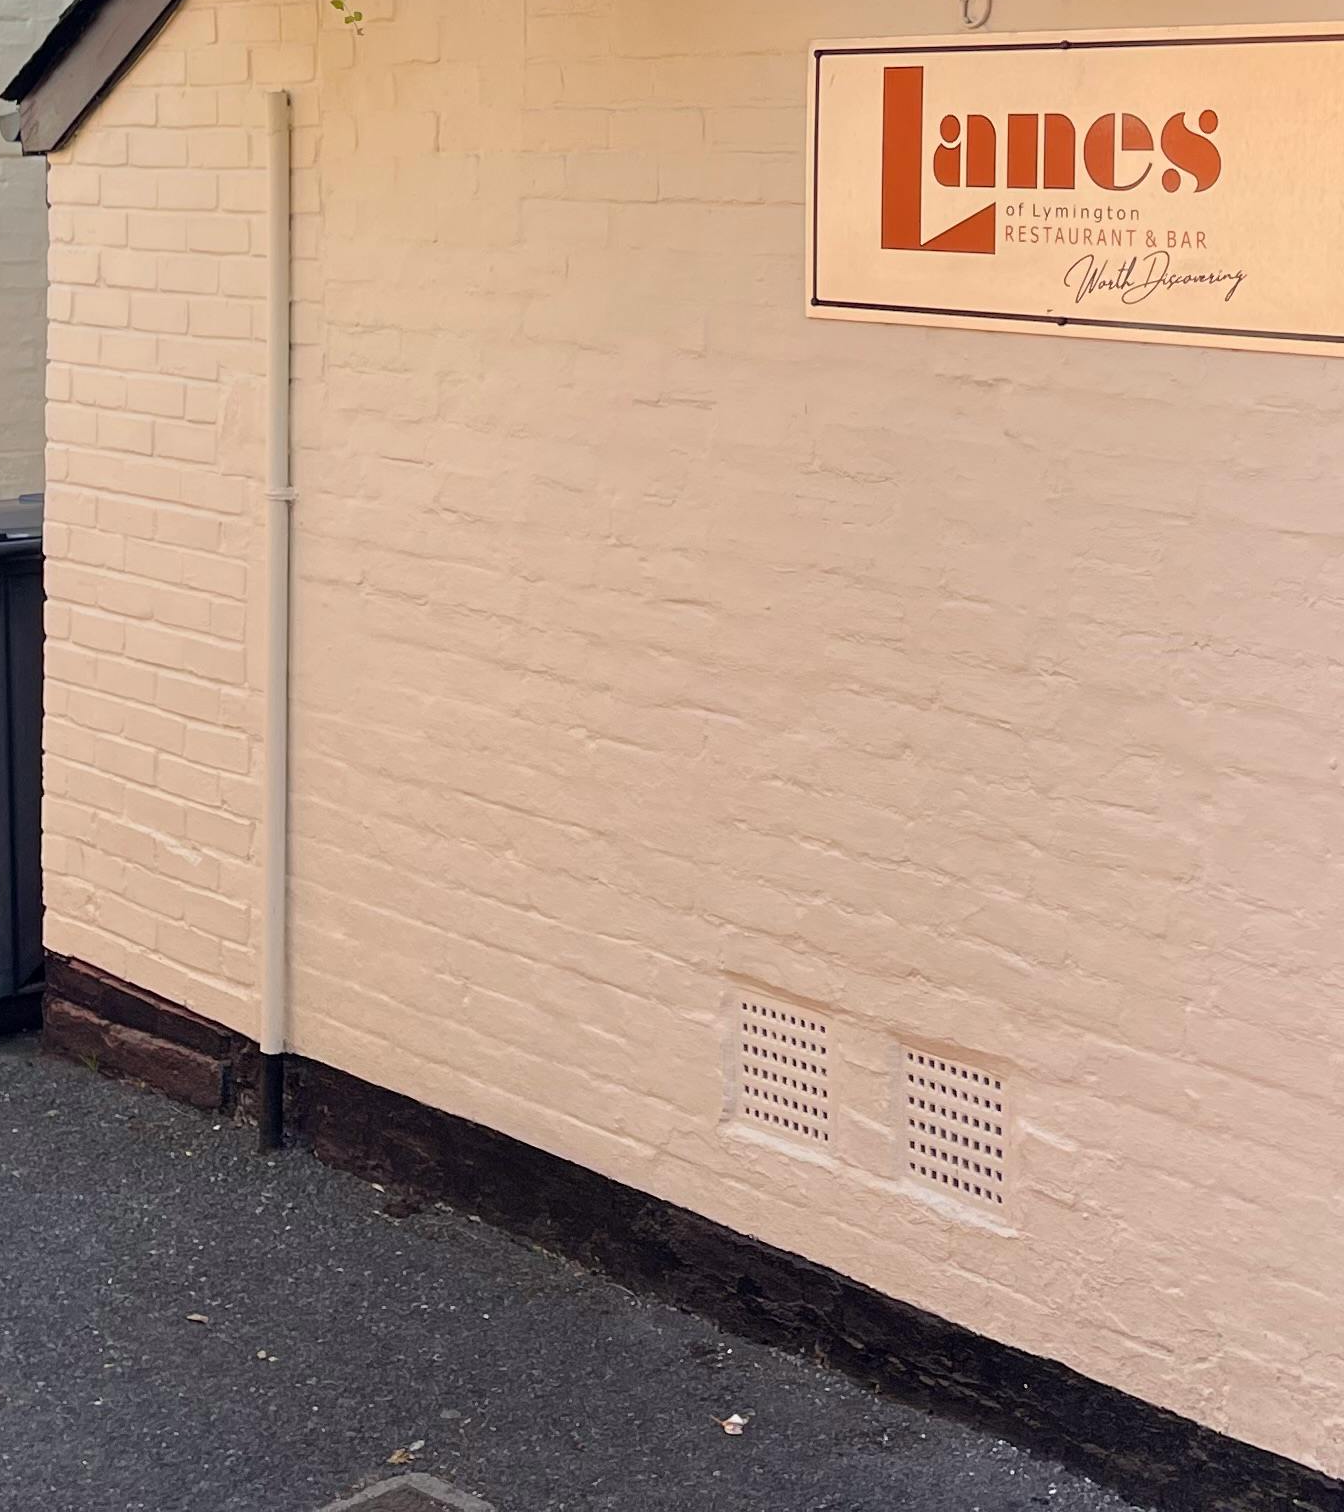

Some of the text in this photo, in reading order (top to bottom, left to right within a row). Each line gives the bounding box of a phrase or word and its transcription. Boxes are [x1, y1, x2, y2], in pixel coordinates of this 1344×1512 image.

[881, 65, 1222, 255] Lanes
[1005, 202, 1140, 223] of Lymington
[1004, 224, 1208, 250] RESTAURANT & BAR
[1063, 250, 1248, 305] Worth Discovering
